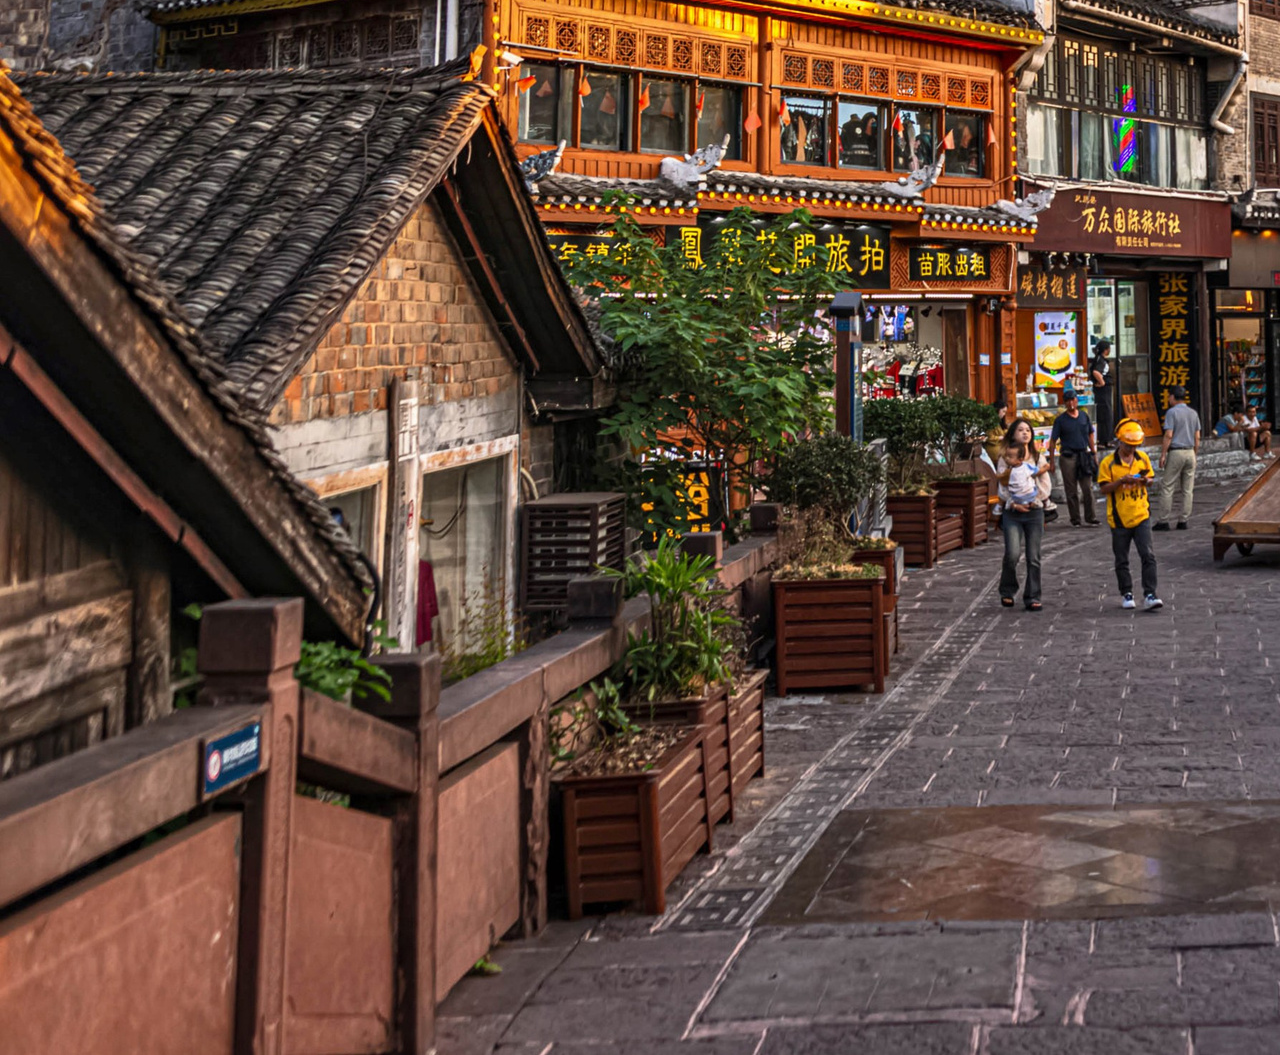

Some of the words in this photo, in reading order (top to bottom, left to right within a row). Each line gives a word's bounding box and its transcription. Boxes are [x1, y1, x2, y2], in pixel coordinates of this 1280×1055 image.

[1082, 206, 1181, 237] 万众国际旅行社
[917, 252, 987, 277] 苗服出租
[1158, 273, 1191, 427] 张家界旅游
